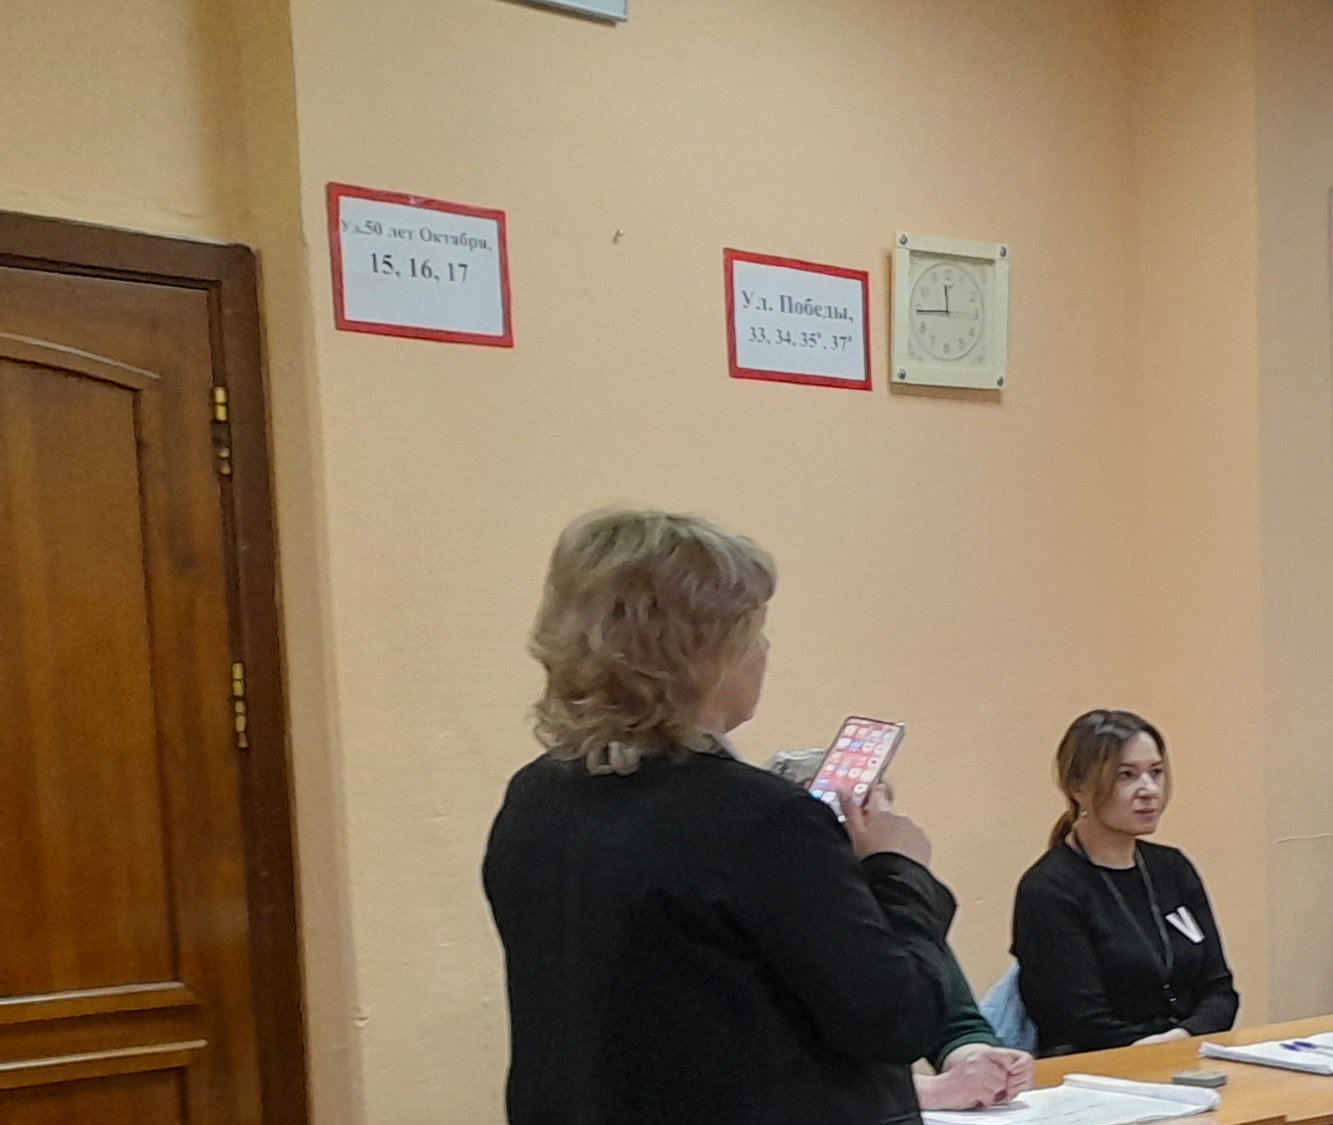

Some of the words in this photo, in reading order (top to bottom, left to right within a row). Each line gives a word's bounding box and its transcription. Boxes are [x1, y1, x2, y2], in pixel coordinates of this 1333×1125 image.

[387, 226, 414, 240] лет
[420, 227, 492, 251] Октября,
[370, 252, 400, 277] 15,
[409, 258, 440, 284] 16,
[448, 262, 468, 283] 17
[742, 290, 773, 312] Ул.
[779, 295, 854, 323] Победы,
[748, 326, 771, 344] 33,
[775, 329, 796, 347] 34,
